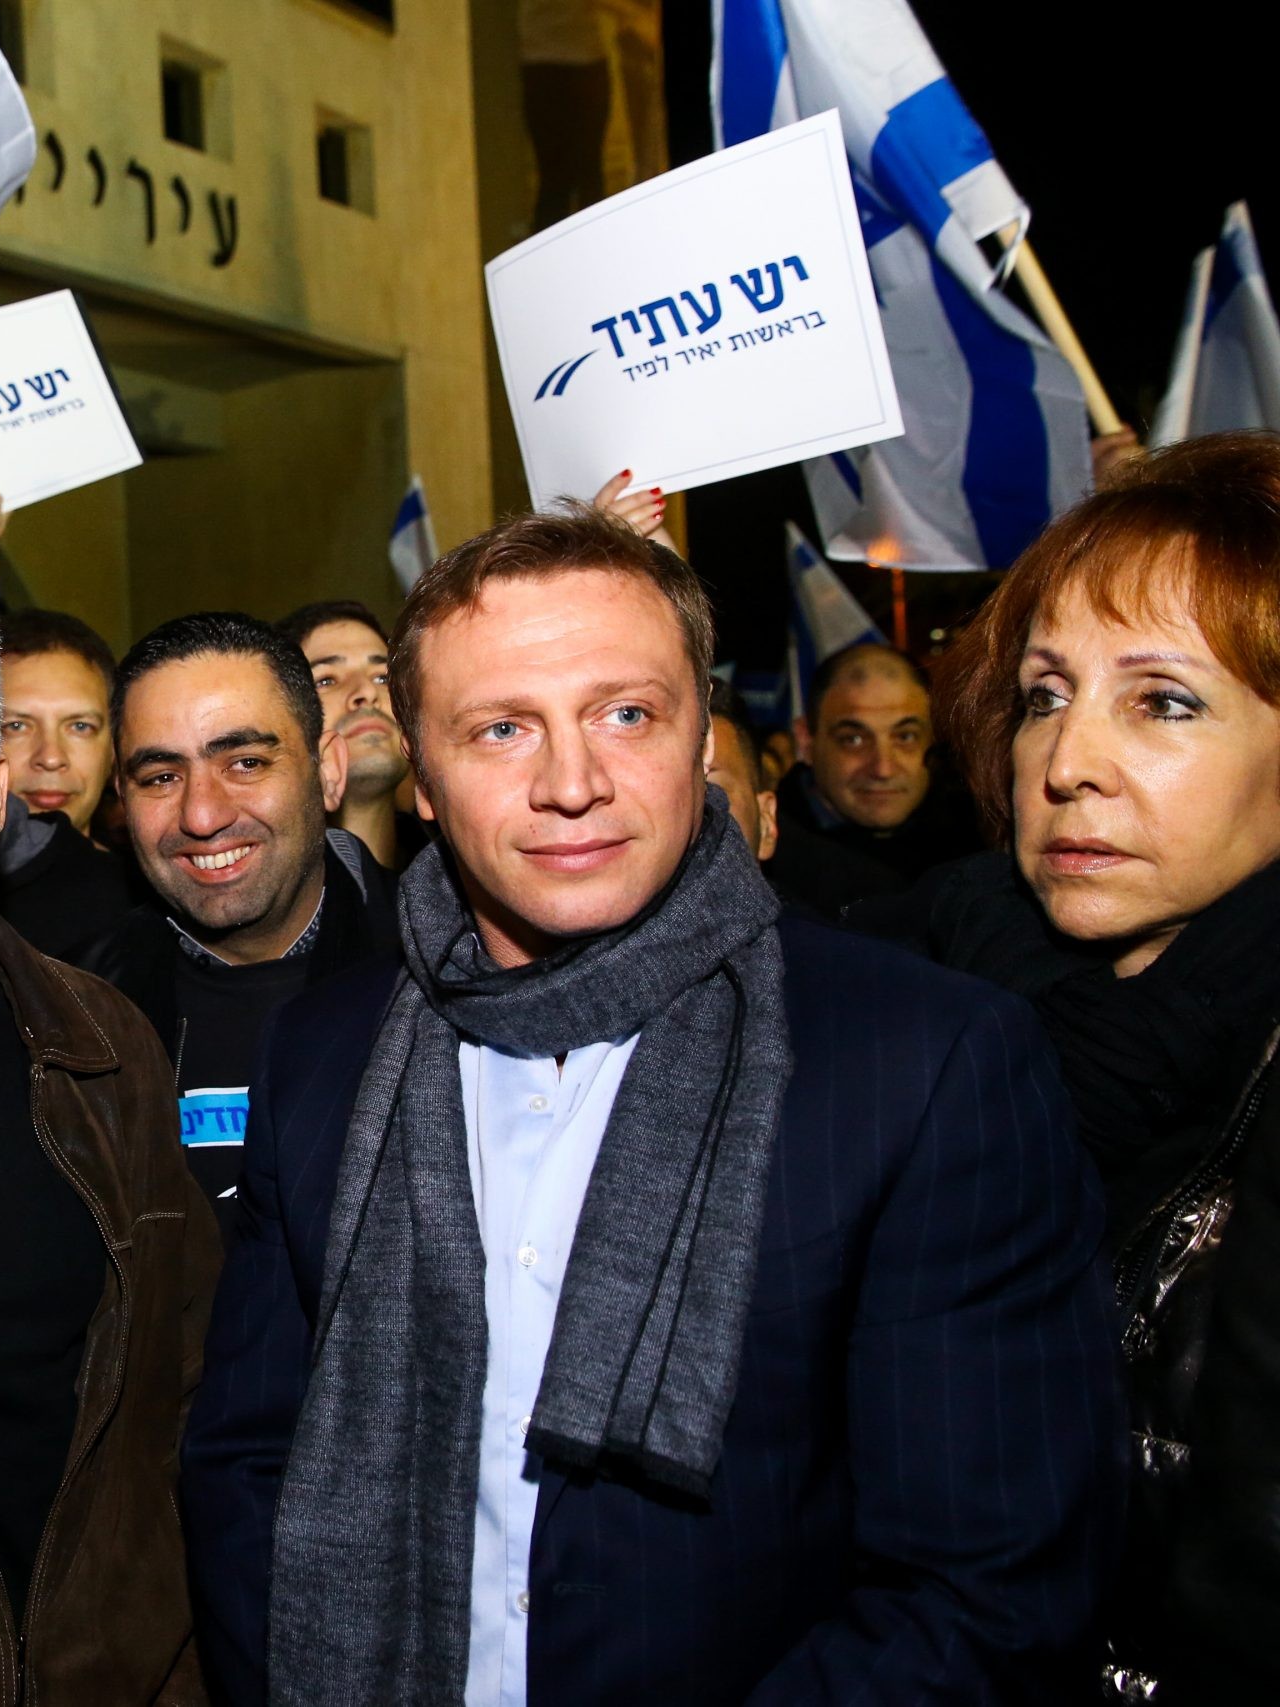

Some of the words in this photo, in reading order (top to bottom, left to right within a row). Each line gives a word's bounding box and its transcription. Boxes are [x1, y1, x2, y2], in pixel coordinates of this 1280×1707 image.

[16, 130, 239, 268] עיריי
[729, 254, 810, 314] יש
[591, 282, 722, 358] עתיד
[728, 310, 826, 352] בראשות
[622, 355, 670, 382] לפיד
[675, 340, 722, 365] יאיר
[24, 367, 70, 400] יש
